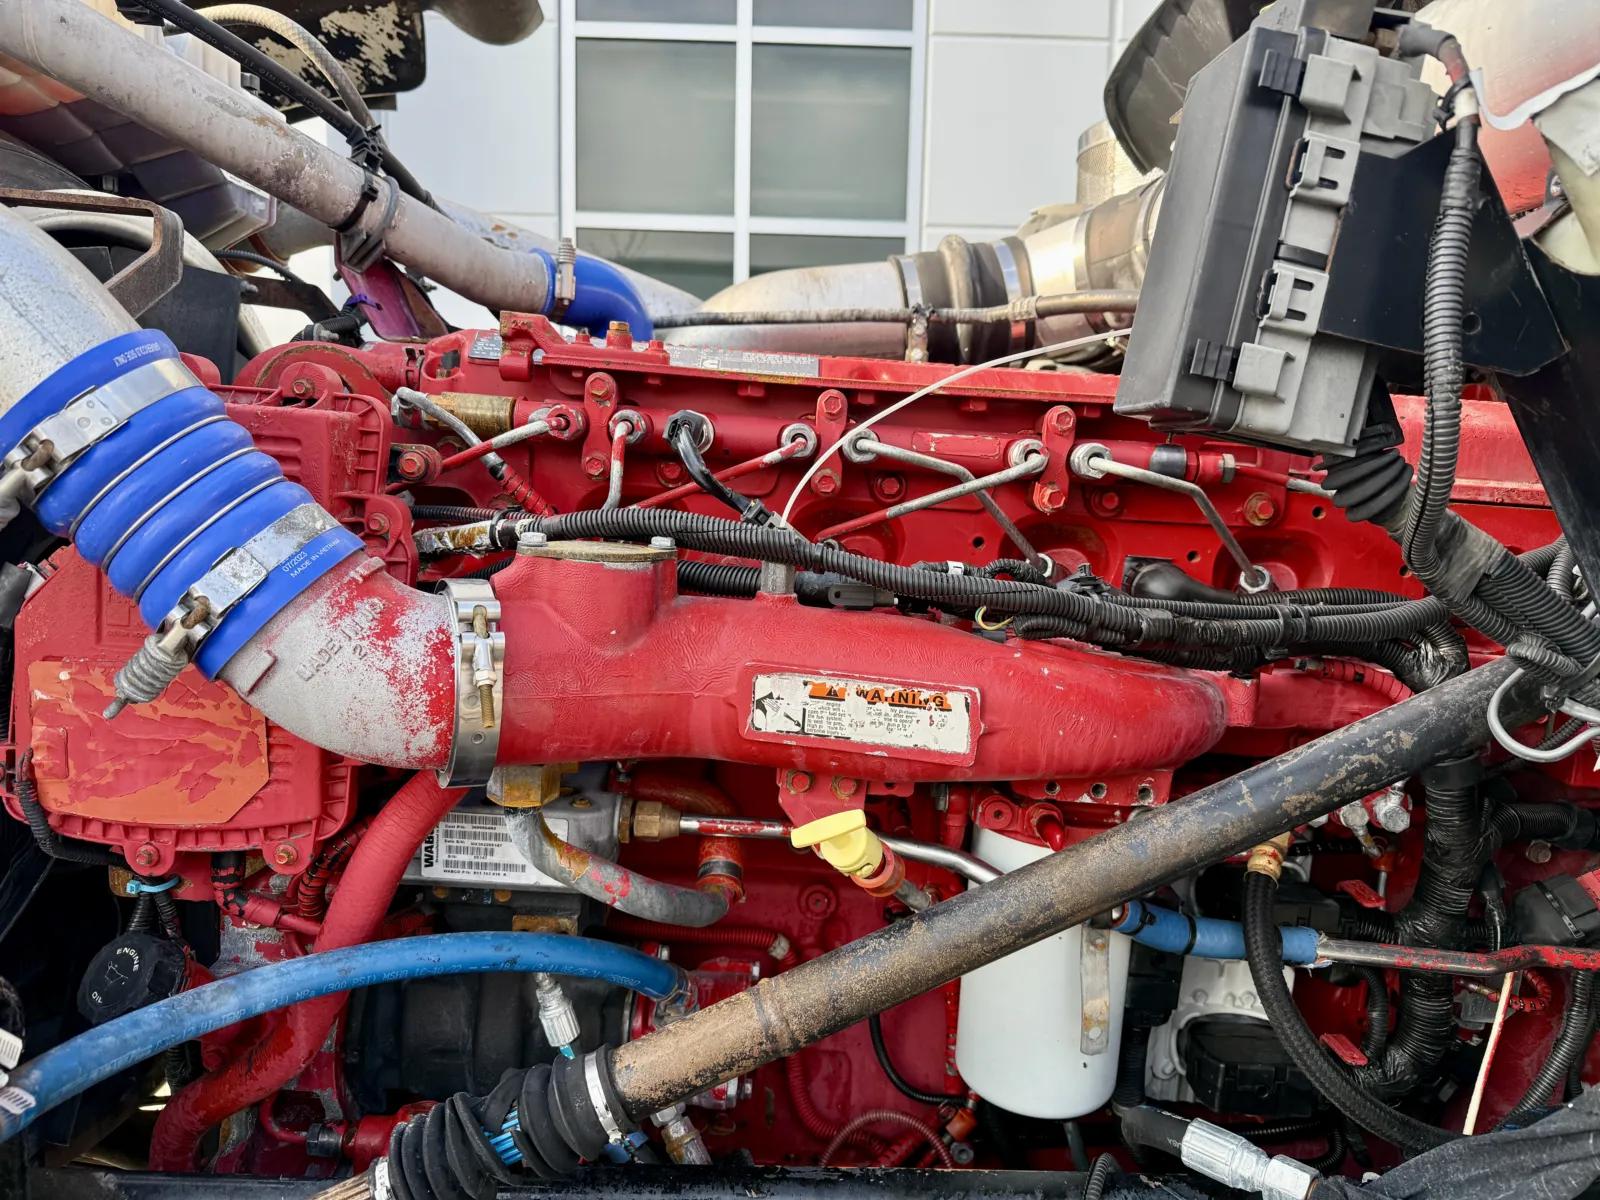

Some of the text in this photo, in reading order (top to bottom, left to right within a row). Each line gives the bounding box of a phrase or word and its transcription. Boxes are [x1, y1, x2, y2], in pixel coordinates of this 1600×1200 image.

[282, 552, 308, 573] 07/2023
[290, 560, 312, 578] MADE
[310, 553, 320, 563] IN
[295, 637, 343, 682] MADE
[352, 643, 368, 660] 2
[856, 687, 945, 707] WARNING
[116, 947, 141, 972] ENGINE
[91, 991, 103, 1004] OIL
